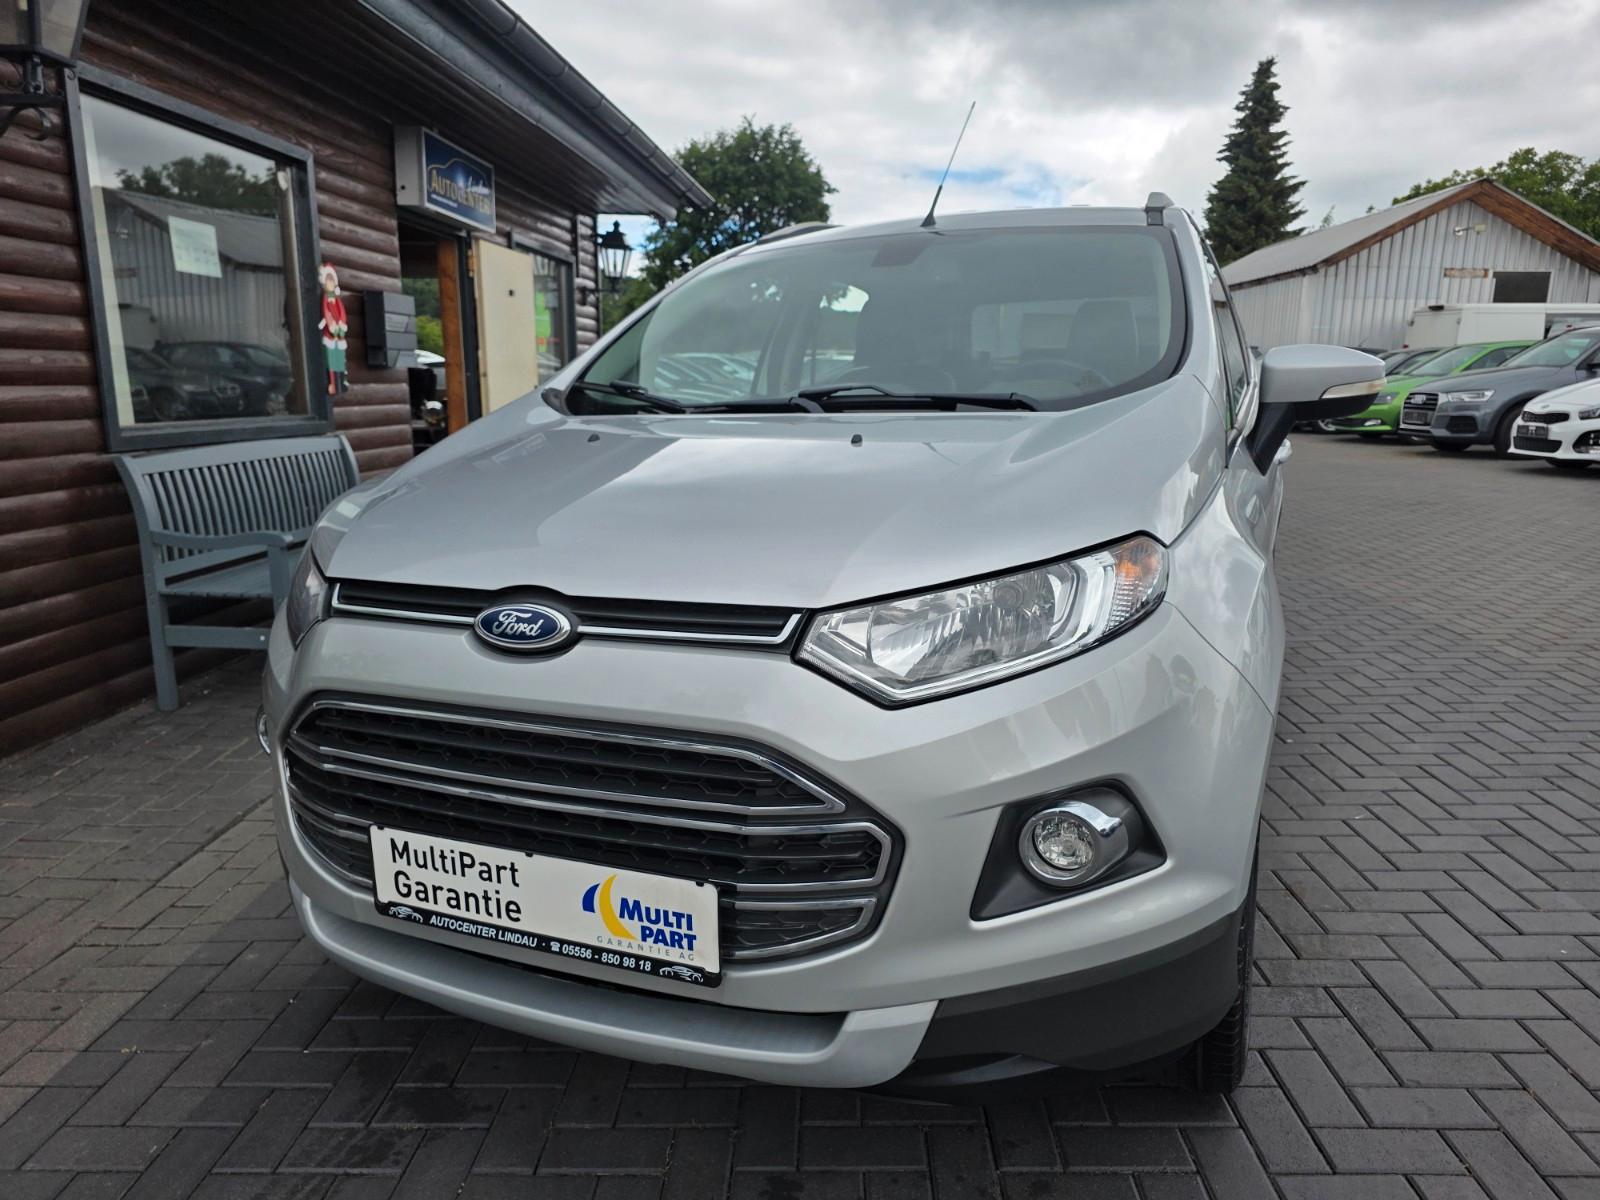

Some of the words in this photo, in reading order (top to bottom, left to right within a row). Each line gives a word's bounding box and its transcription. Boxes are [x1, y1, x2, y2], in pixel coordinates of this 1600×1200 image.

[492, 610, 544, 637] Ford
[390, 837, 520, 888] MultiPart
[394, 870, 522, 923] Garantie
[619, 897, 693, 931] MULTI
[429, 915, 496, 939] AUTOCENTER
[498, 930, 537, 948] LINDAU
[562, 944, 592, 960] 05556
[601, 952, 620, 965] 850
[622, 957, 635, 969] 98
[638, 959, 652, 972] 18
[596, 935, 670, 957] GARANTIE
[679, 951, 695, 961] AG
[640, 925, 696, 951] PART
